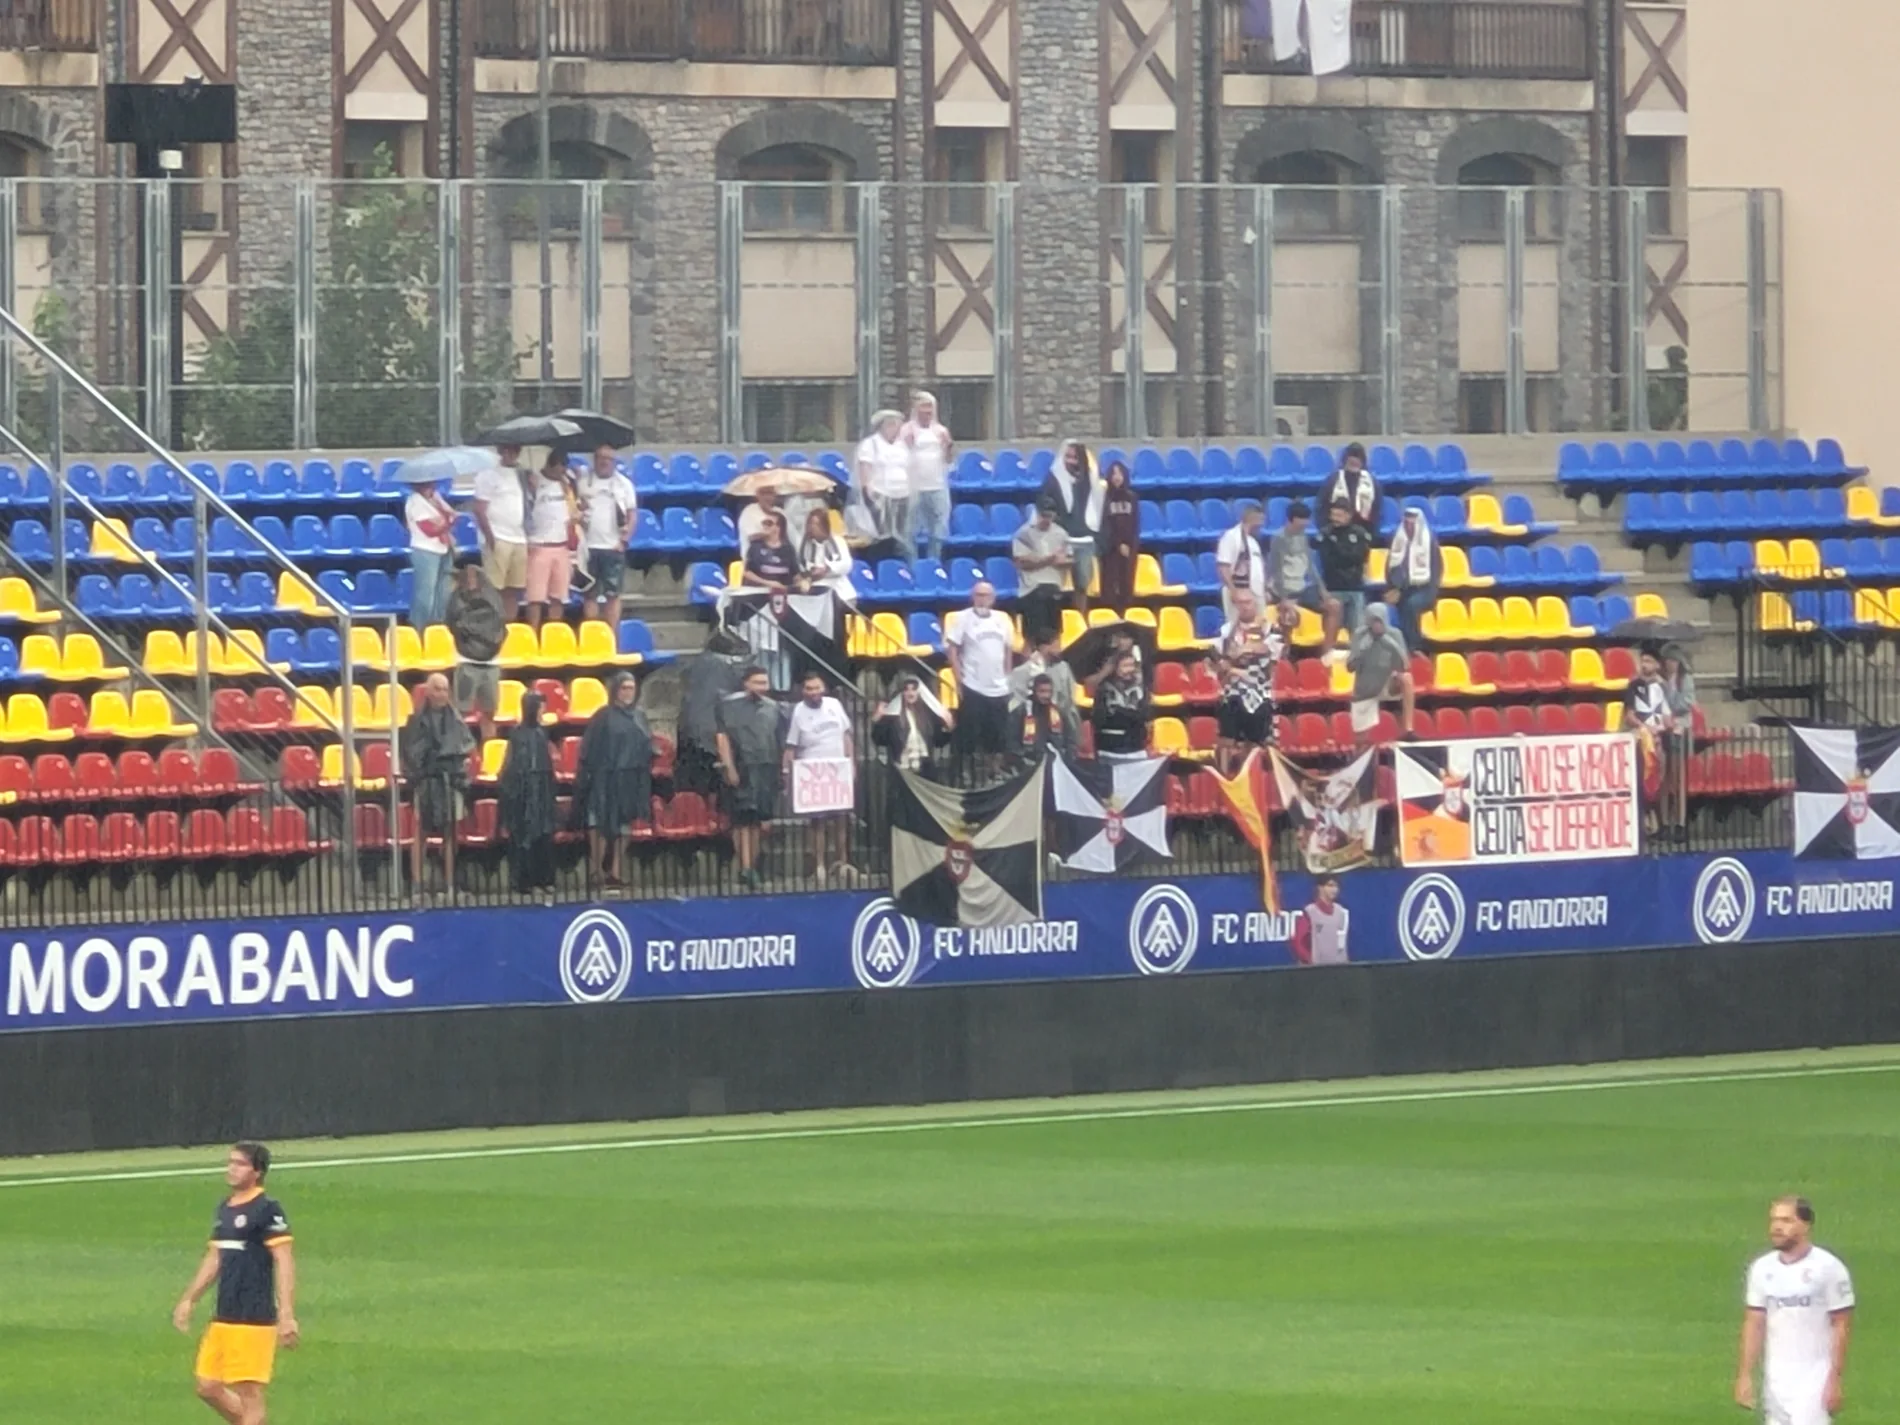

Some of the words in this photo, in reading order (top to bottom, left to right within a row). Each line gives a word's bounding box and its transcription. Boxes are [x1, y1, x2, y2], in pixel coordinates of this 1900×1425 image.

[1473, 746, 1525, 796] CEUTA
[1526, 745, 1550, 794] NO
[1554, 744, 1575, 792] SE
[1578, 741, 1631, 791] VENDE
[1475, 806, 1527, 856] CEUTA
[1528, 804, 1550, 853] SE
[1476, 901, 1502, 932] FC
[1507, 896, 1608, 930] ANDORRA
[1767, 886, 1792, 916] FC
[1797, 881, 1894, 914] ANDORRA
[934, 927, 962, 960] FC
[969, 920, 1078, 956] ANDORRA
[1212, 913, 1239, 944] FC
[7, 925, 414, 1015] MORABANC
[646, 940, 675, 973] FC
[680, 934, 796, 971] ANDORRA
